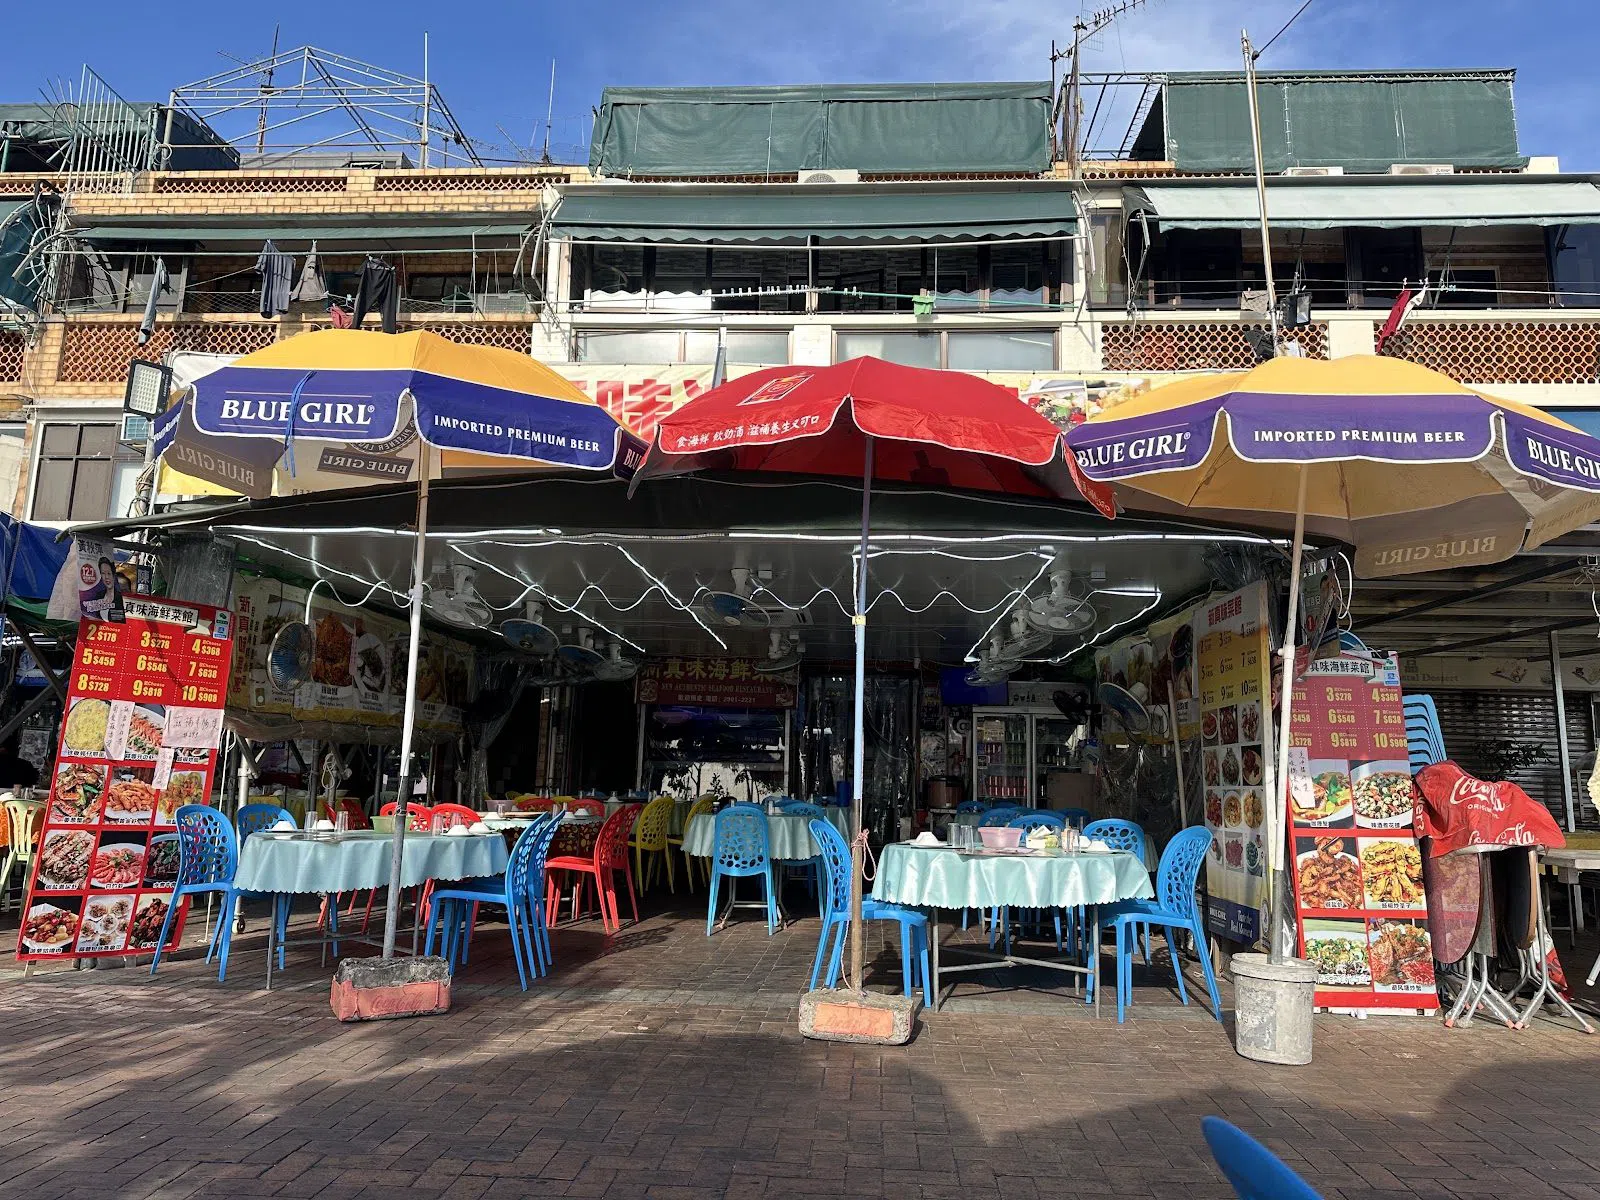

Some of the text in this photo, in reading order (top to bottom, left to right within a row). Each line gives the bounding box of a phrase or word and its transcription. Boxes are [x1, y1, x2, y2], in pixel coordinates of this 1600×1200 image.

[220, 399, 372, 425] BLUE GIRL
[434, 415, 600, 452] IMPORTED PREMIUM BEER
[1253, 430, 1466, 444] IMPORTED PREMIUM BEER
[1076, 432, 1187, 468] BLUE GIRL
[1526, 437, 1575, 472] BLUE
[623, 448, 642, 471] BLU
[86, 623, 117, 643] 2 $178
[141, 631, 170, 650] 3 $278
[192, 639, 221, 657] 4 $368
[82, 648, 115, 667] 5 $458
[136, 655, 167, 673] 6 $548
[188, 661, 217, 679] 7 $638
[78, 674, 109, 692] 8 $728
[133, 680, 163, 697] 9 $818
[182, 685, 218, 703] 10 $908
[1292, 692, 1307, 701] $178
[1326, 687, 1352, 702] 3 $278
[1372, 688, 1399, 702] 4 $368
[1293, 714, 1311, 722] $458
[1328, 709, 1356, 724] 6 $548
[1373, 710, 1402, 725] 7 $638
[1295, 738, 1312, 746] $728
[1330, 733, 1357, 748] 9 $818
[1373, 733, 1408, 748] 10 $908
